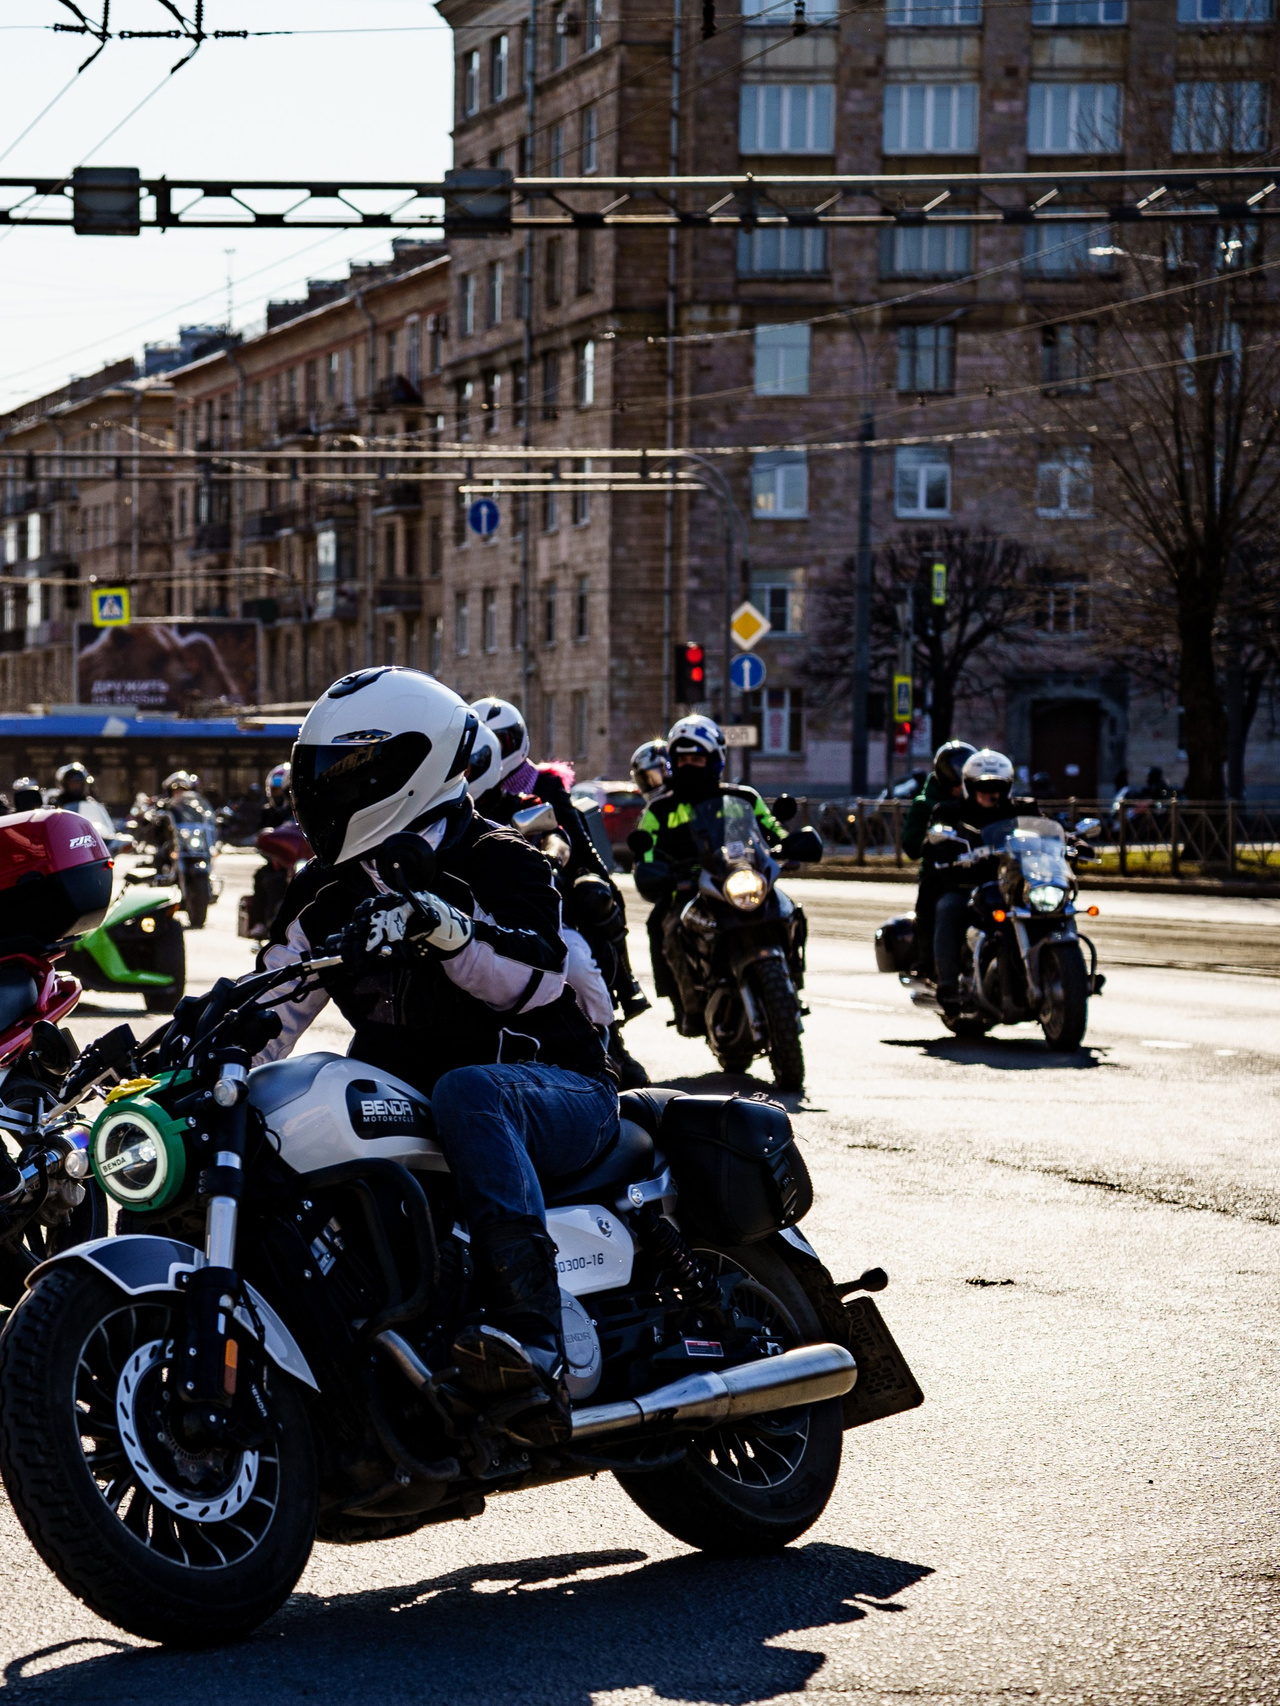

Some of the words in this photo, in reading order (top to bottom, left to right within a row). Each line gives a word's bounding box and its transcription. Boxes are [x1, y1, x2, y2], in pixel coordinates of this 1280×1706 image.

[361, 1100, 413, 1116] BENDA
[102, 1156, 126, 1173] BENDA
[555, 1253, 604, 1273] D300-16
[564, 1332, 591, 1343] ENDA
